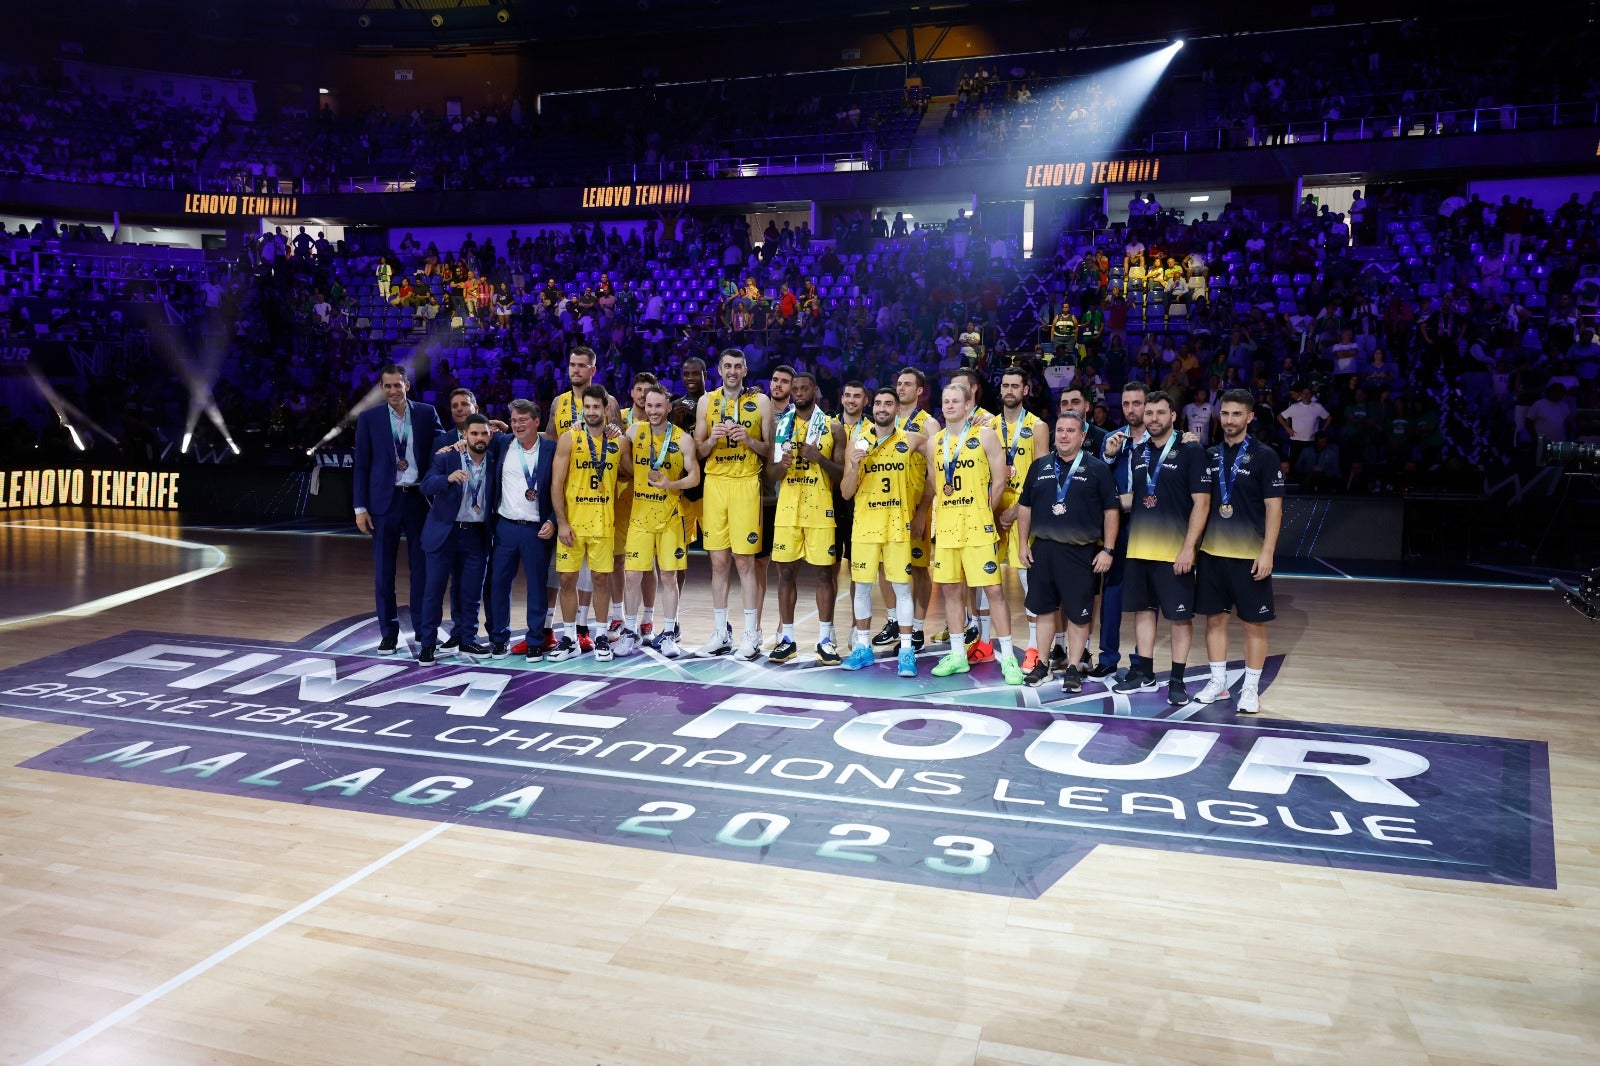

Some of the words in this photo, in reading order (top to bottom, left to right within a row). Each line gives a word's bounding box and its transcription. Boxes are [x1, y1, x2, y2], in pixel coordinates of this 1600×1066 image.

[1025, 162, 1086, 188] LENOVO
[185, 193, 237, 215] LENOVO
[582, 185, 631, 208] LENOVO
[0, 347, 31, 360] UR
[635, 454, 672, 469] Levo
[863, 462, 905, 473] Lenovo
[937, 459, 975, 471] Lovo
[0, 468, 84, 508] LENOVO
[91, 469, 180, 509] TENERIFE
[881, 477, 891, 493] 3
[66, 643, 627, 729] FINAL
[672, 693, 1430, 807] FOUR
[0, 682, 414, 738] BASKETBALL
[434, 725, 966, 796] CHAMPIONS
[993, 778, 1434, 846] LEAGUE
[82, 740, 545, 818] MALAGA
[615, 800, 995, 875] 2023
